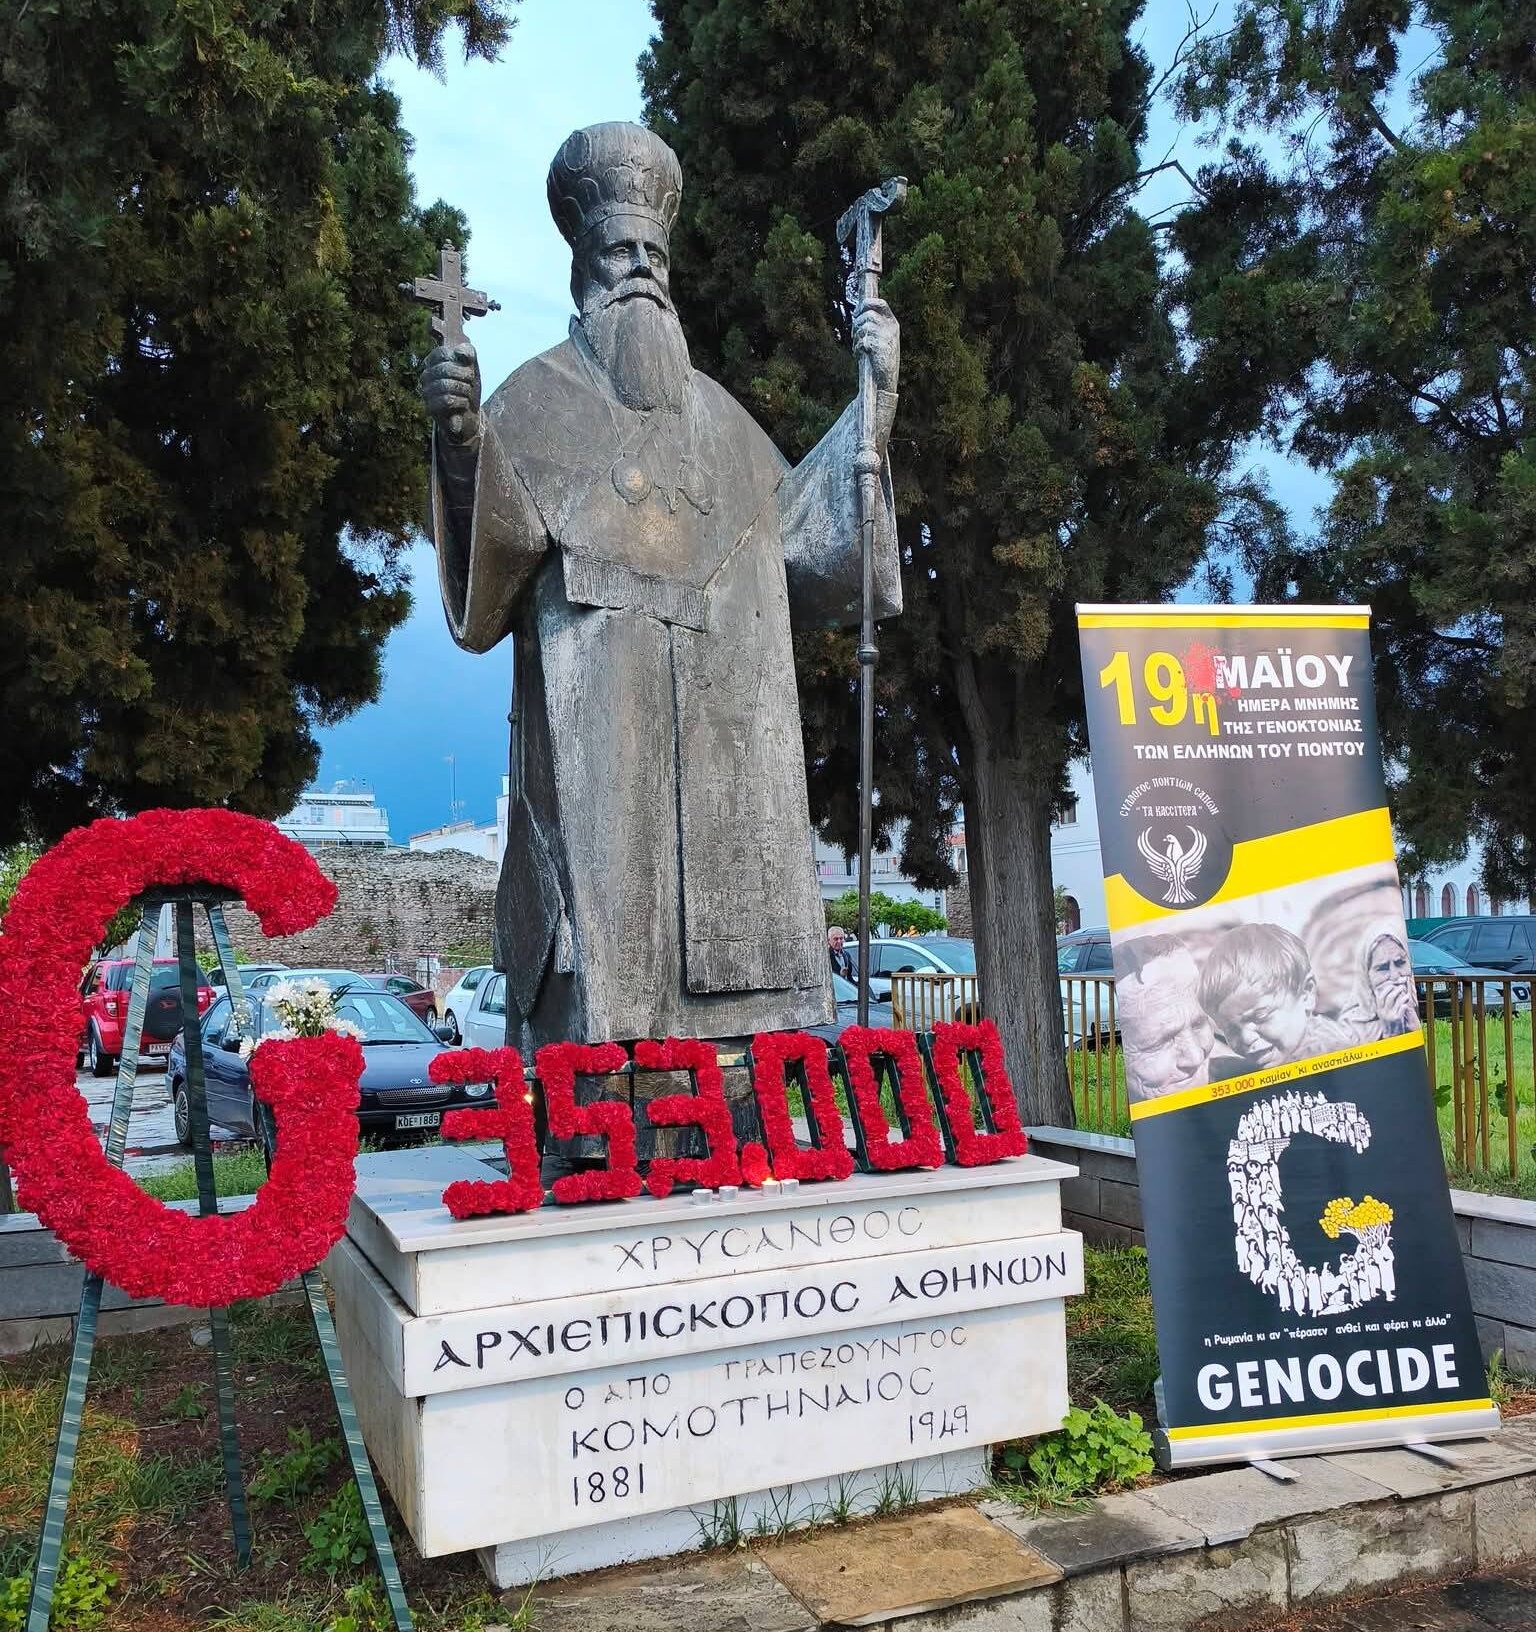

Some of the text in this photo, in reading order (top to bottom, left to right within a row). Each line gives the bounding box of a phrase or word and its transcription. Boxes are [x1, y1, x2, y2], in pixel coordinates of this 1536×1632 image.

[1212, 648, 1353, 689] ΜΑΪΟΥ
[1238, 697, 1359, 712] ΗΜΕΡΑ ΜΝΗΜΗΣ
[1223, 719, 1363, 735] ΤΗΣ ΓΕΝΟΚΤΟΝΙΑΣ
[1133, 742, 1365, 760] ΤΩΝ ΕΛΛΗΝΩΝ ΤΟΥ ΠΟΝΤΟΥ
[1211, 1077, 1256, 1098] 353.000
[1259, 1069, 1292, 1086] καμίαν
[1204, 1337, 1212, 1347] η
[1214, 1331, 1254, 1346] Ρωμανία
[1256, 1332, 1266, 1341] κι
[1269, 1331, 1281, 1341] αν
[1335, 1322, 1362, 1334] ανθεί
[1365, 1323, 1380, 1332] και
[1383, 1319, 1409, 1332] φέρει
[1412, 1320, 1422, 1328] κι
[604, 1373, 672, 1404] ΑΠΟ
[1197, 1342, 1460, 1411] GENOCIDE
[573, 1404, 969, 1507] 1881 1949
